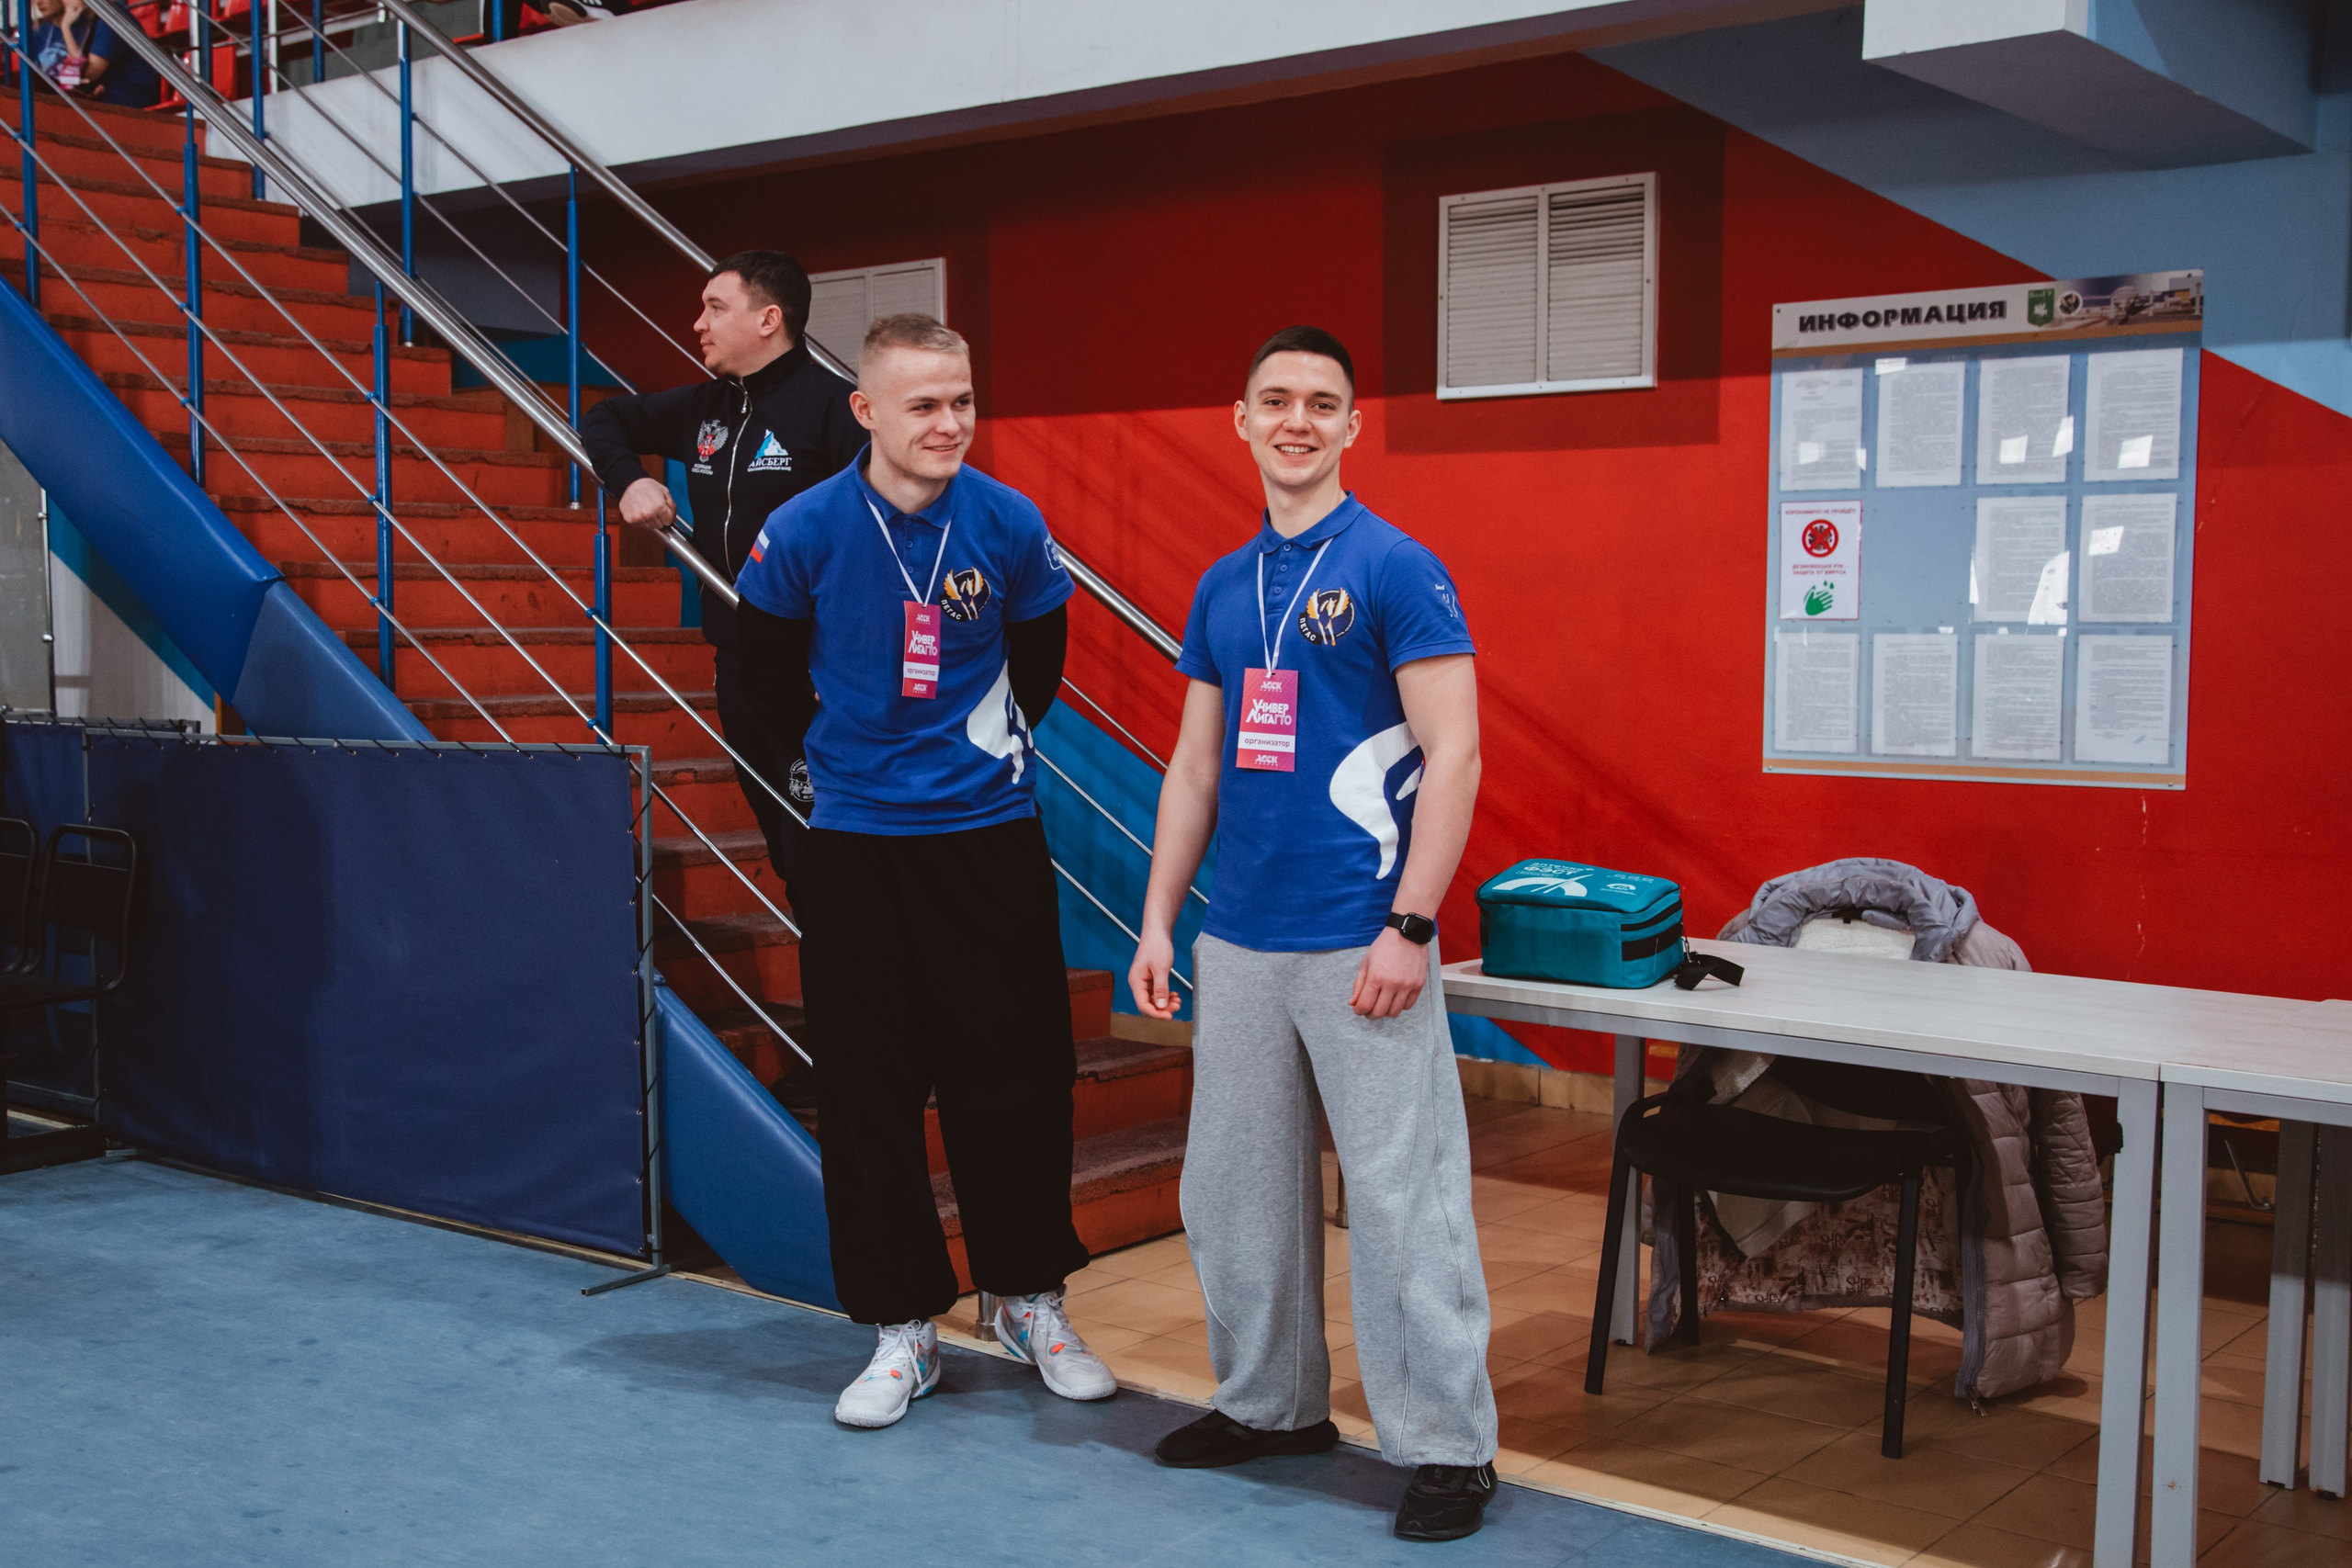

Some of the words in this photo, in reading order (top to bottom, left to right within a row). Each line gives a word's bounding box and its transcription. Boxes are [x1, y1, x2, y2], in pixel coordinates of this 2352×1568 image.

[1798, 299, 2007, 333] ИНФОРМАЦИЯ
[748, 457, 792, 468] АЙСБЕРГ
[941, 599, 961, 620] ПЕГАС
[1299, 617, 1317, 641] ПЕГАС
[907, 667, 936, 677] организатор
[1244, 738, 1290, 749] организатор
